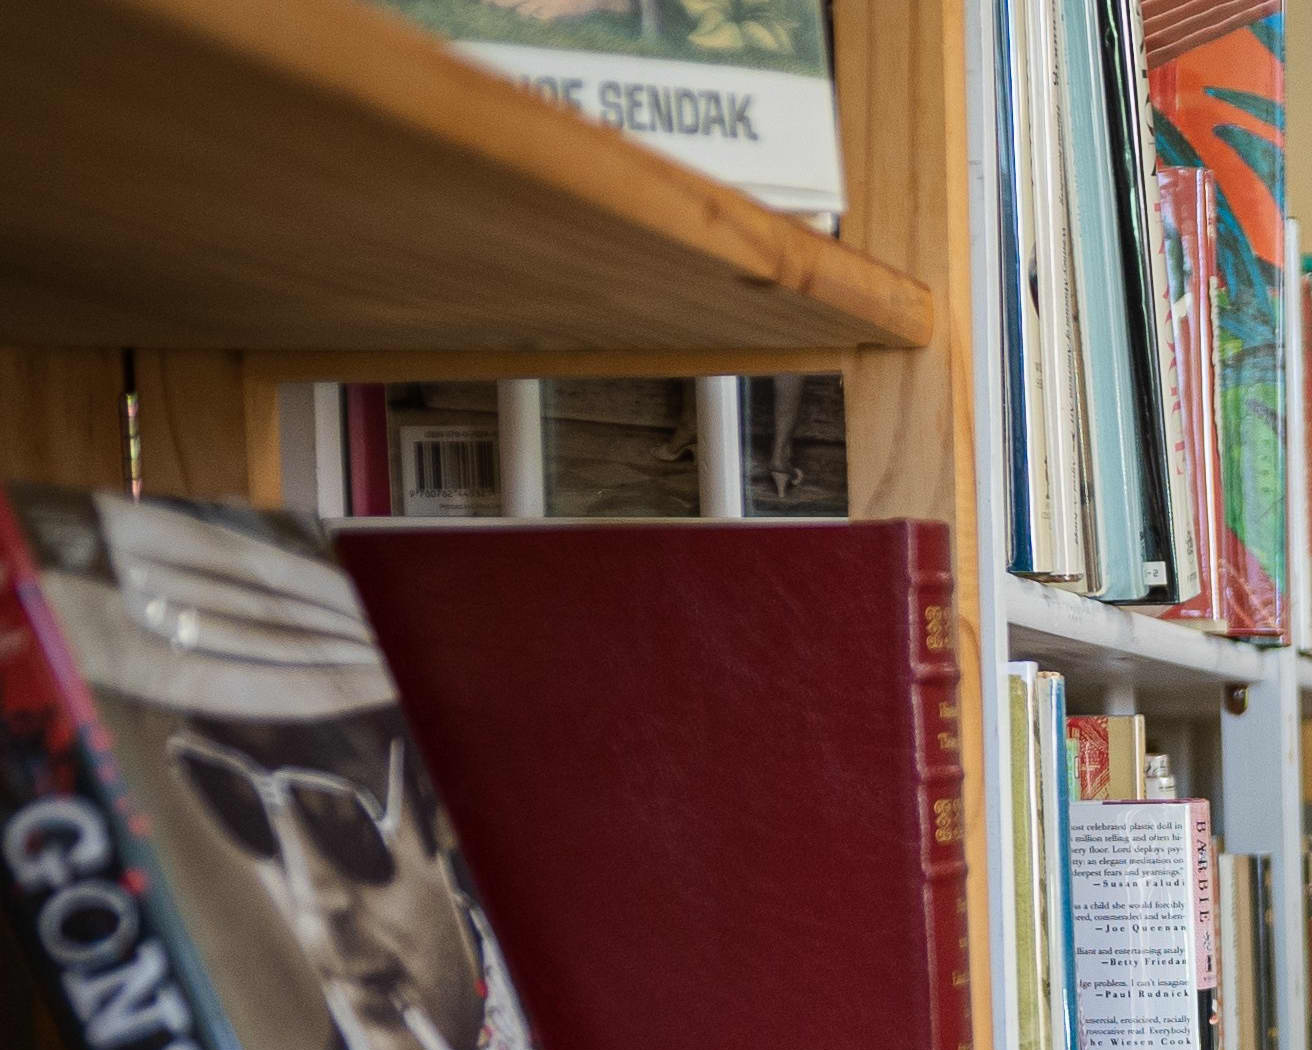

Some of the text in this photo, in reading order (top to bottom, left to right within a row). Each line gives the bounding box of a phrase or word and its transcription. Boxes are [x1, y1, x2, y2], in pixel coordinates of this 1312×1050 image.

[600, 78, 760, 142] SENDAK
[1157, 822, 1172, 830] doll
[1112, 845, 1131, 853] Lord
[1099, 857, 1126, 866] elegant
[1195, 821, 1211, 923] BARBIE
[1090, 902, 1110, 910] child
[1132, 924, 1186, 933] Queenan
[1098, 947, 1112, 955] and
[1145, 958, 1186, 966] Friedan
[1138, 990, 1189, 998] Rudnick
[1160, 1038, 1192, 1046] Cook
